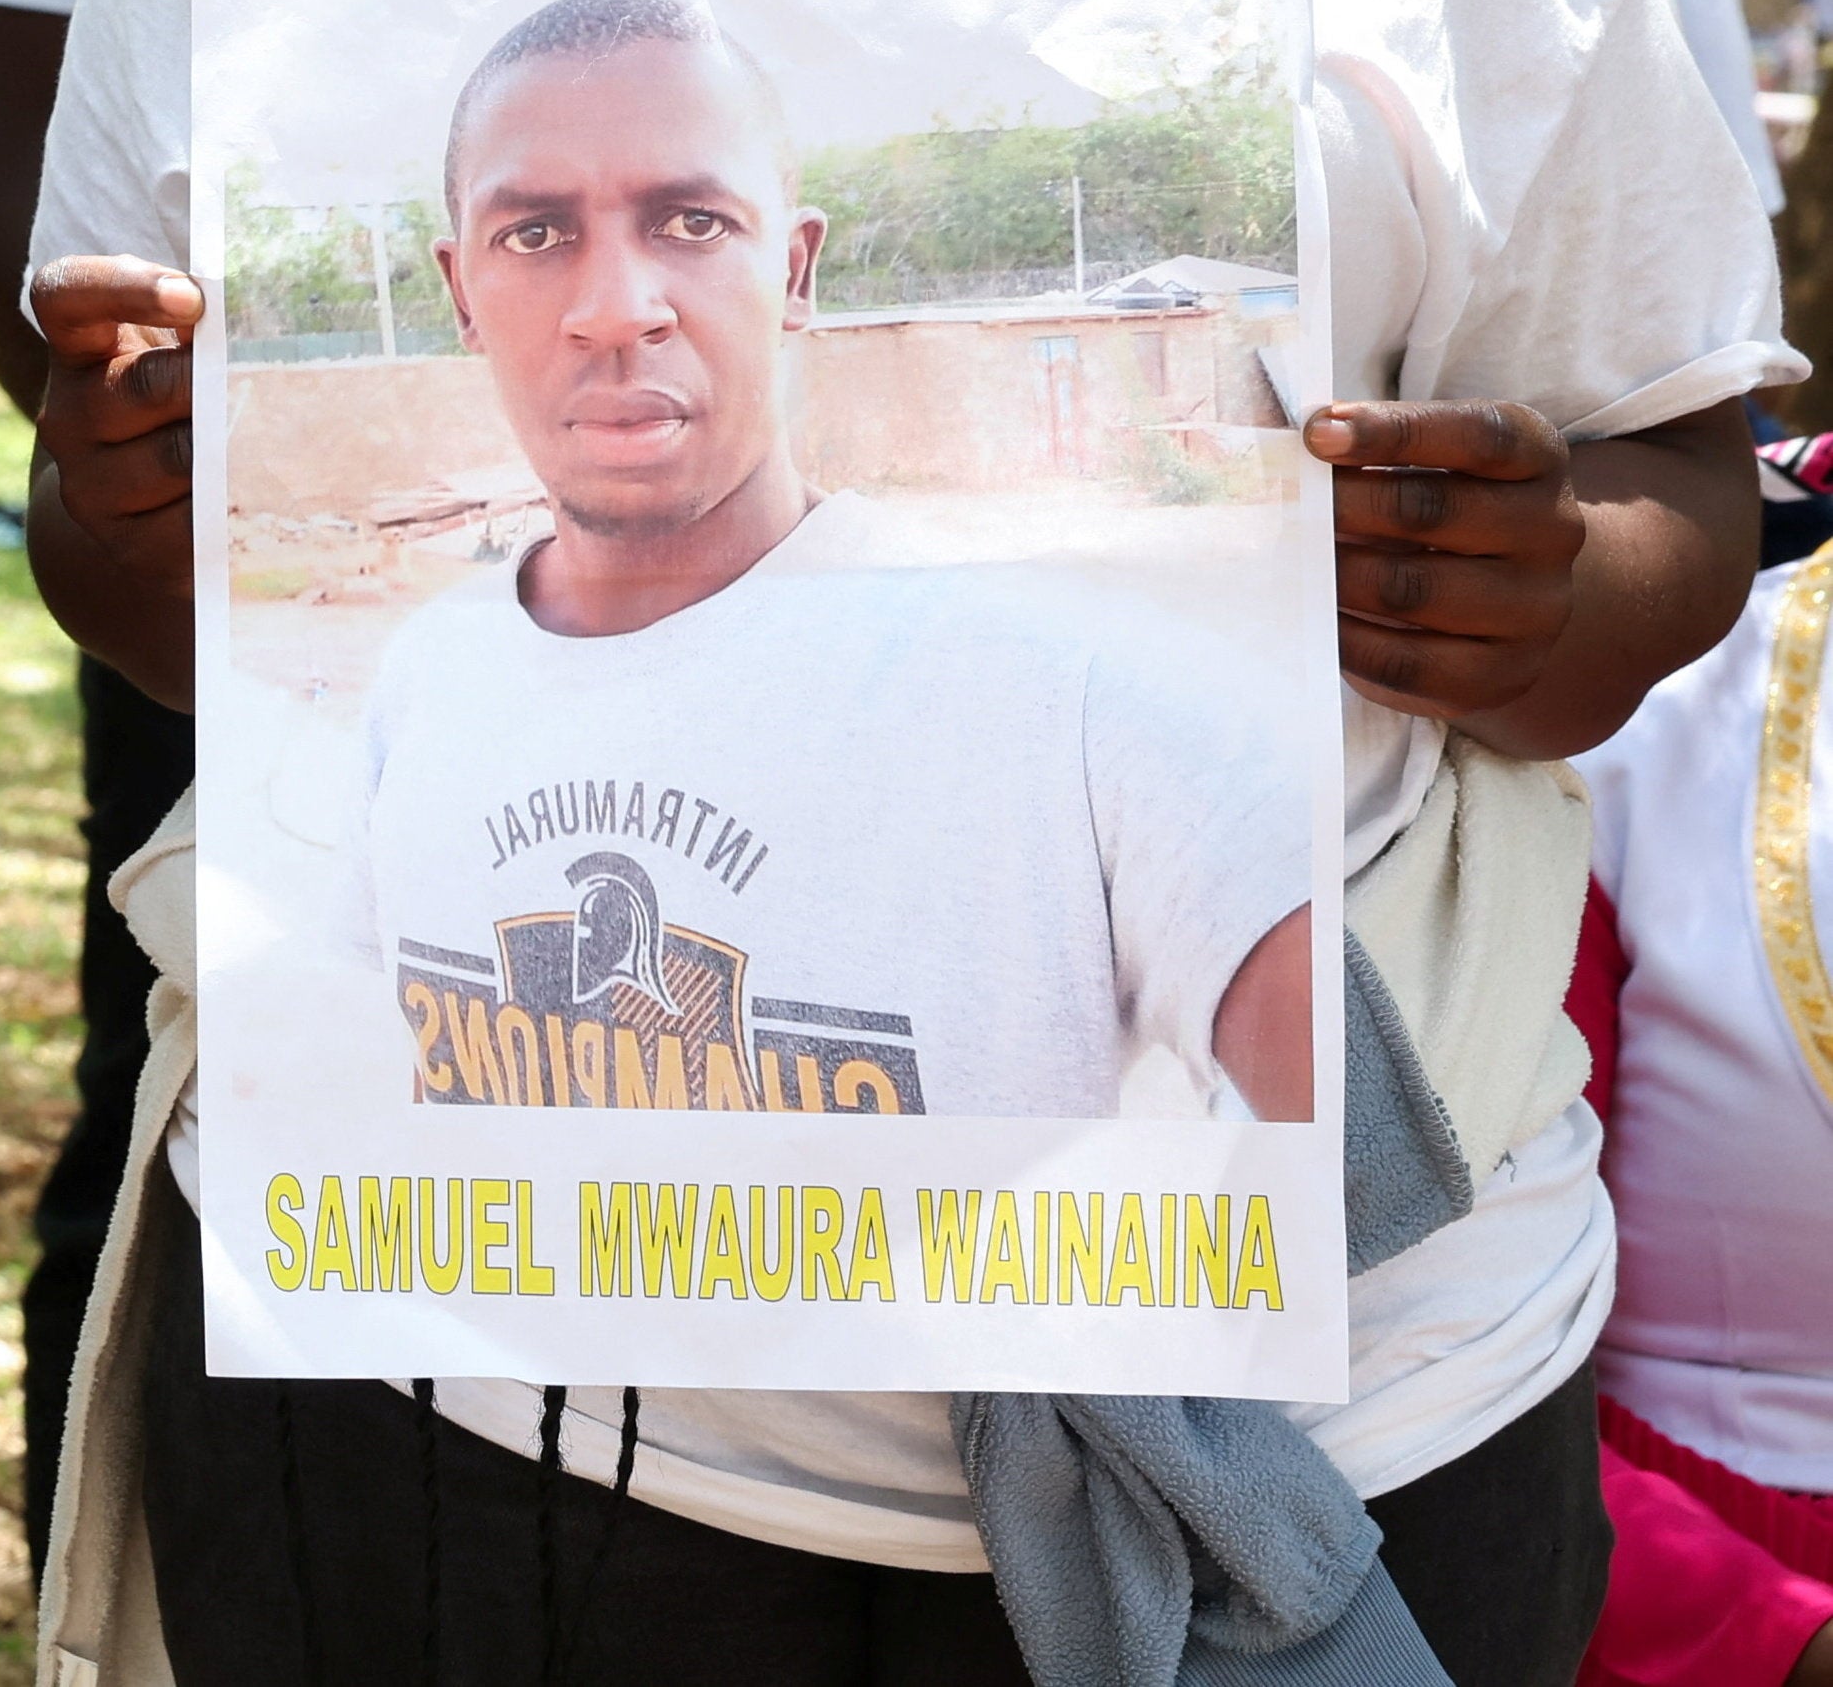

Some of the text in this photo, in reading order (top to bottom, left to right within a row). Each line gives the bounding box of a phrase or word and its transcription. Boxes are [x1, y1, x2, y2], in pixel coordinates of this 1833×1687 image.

[265, 1172, 1284, 1311] SAMUEL MWAURA WAINAINA
